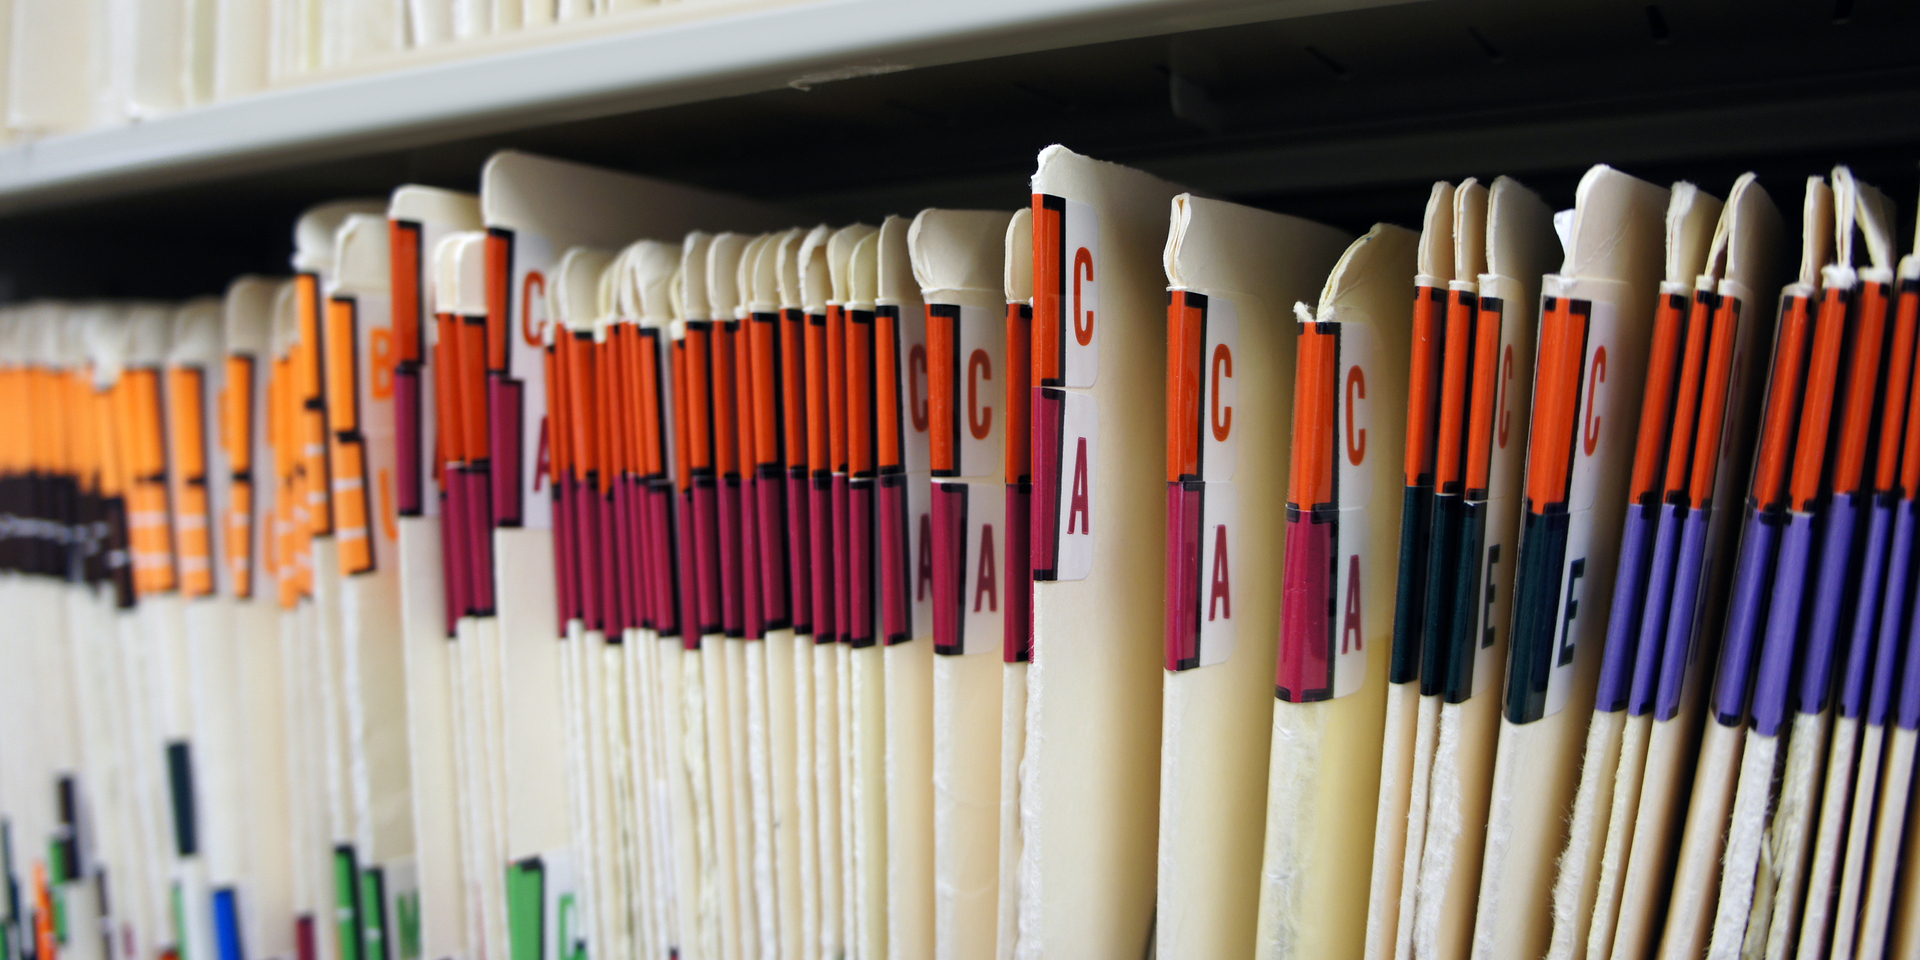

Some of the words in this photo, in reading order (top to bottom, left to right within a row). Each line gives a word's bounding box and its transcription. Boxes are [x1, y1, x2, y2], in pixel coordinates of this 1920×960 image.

[523, 269, 546, 347] C
[1073, 246, 1094, 346] C
[371, 327, 394, 401] B
[909, 343, 928, 432] C
[968, 349, 992, 440] C
[1211, 343, 1233, 442] C
[1498, 344, 1513, 449] C
[1584, 345, 1607, 457] C
[1345, 365, 1367, 467] C
[1067, 436, 1089, 535] A
[917, 513, 933, 602] A
[974, 524, 998, 612] A
[1208, 524, 1231, 621] A
[1341, 554, 1362, 655] A
[1481, 543, 1501, 649] E
[1557, 557, 1586, 668] E
